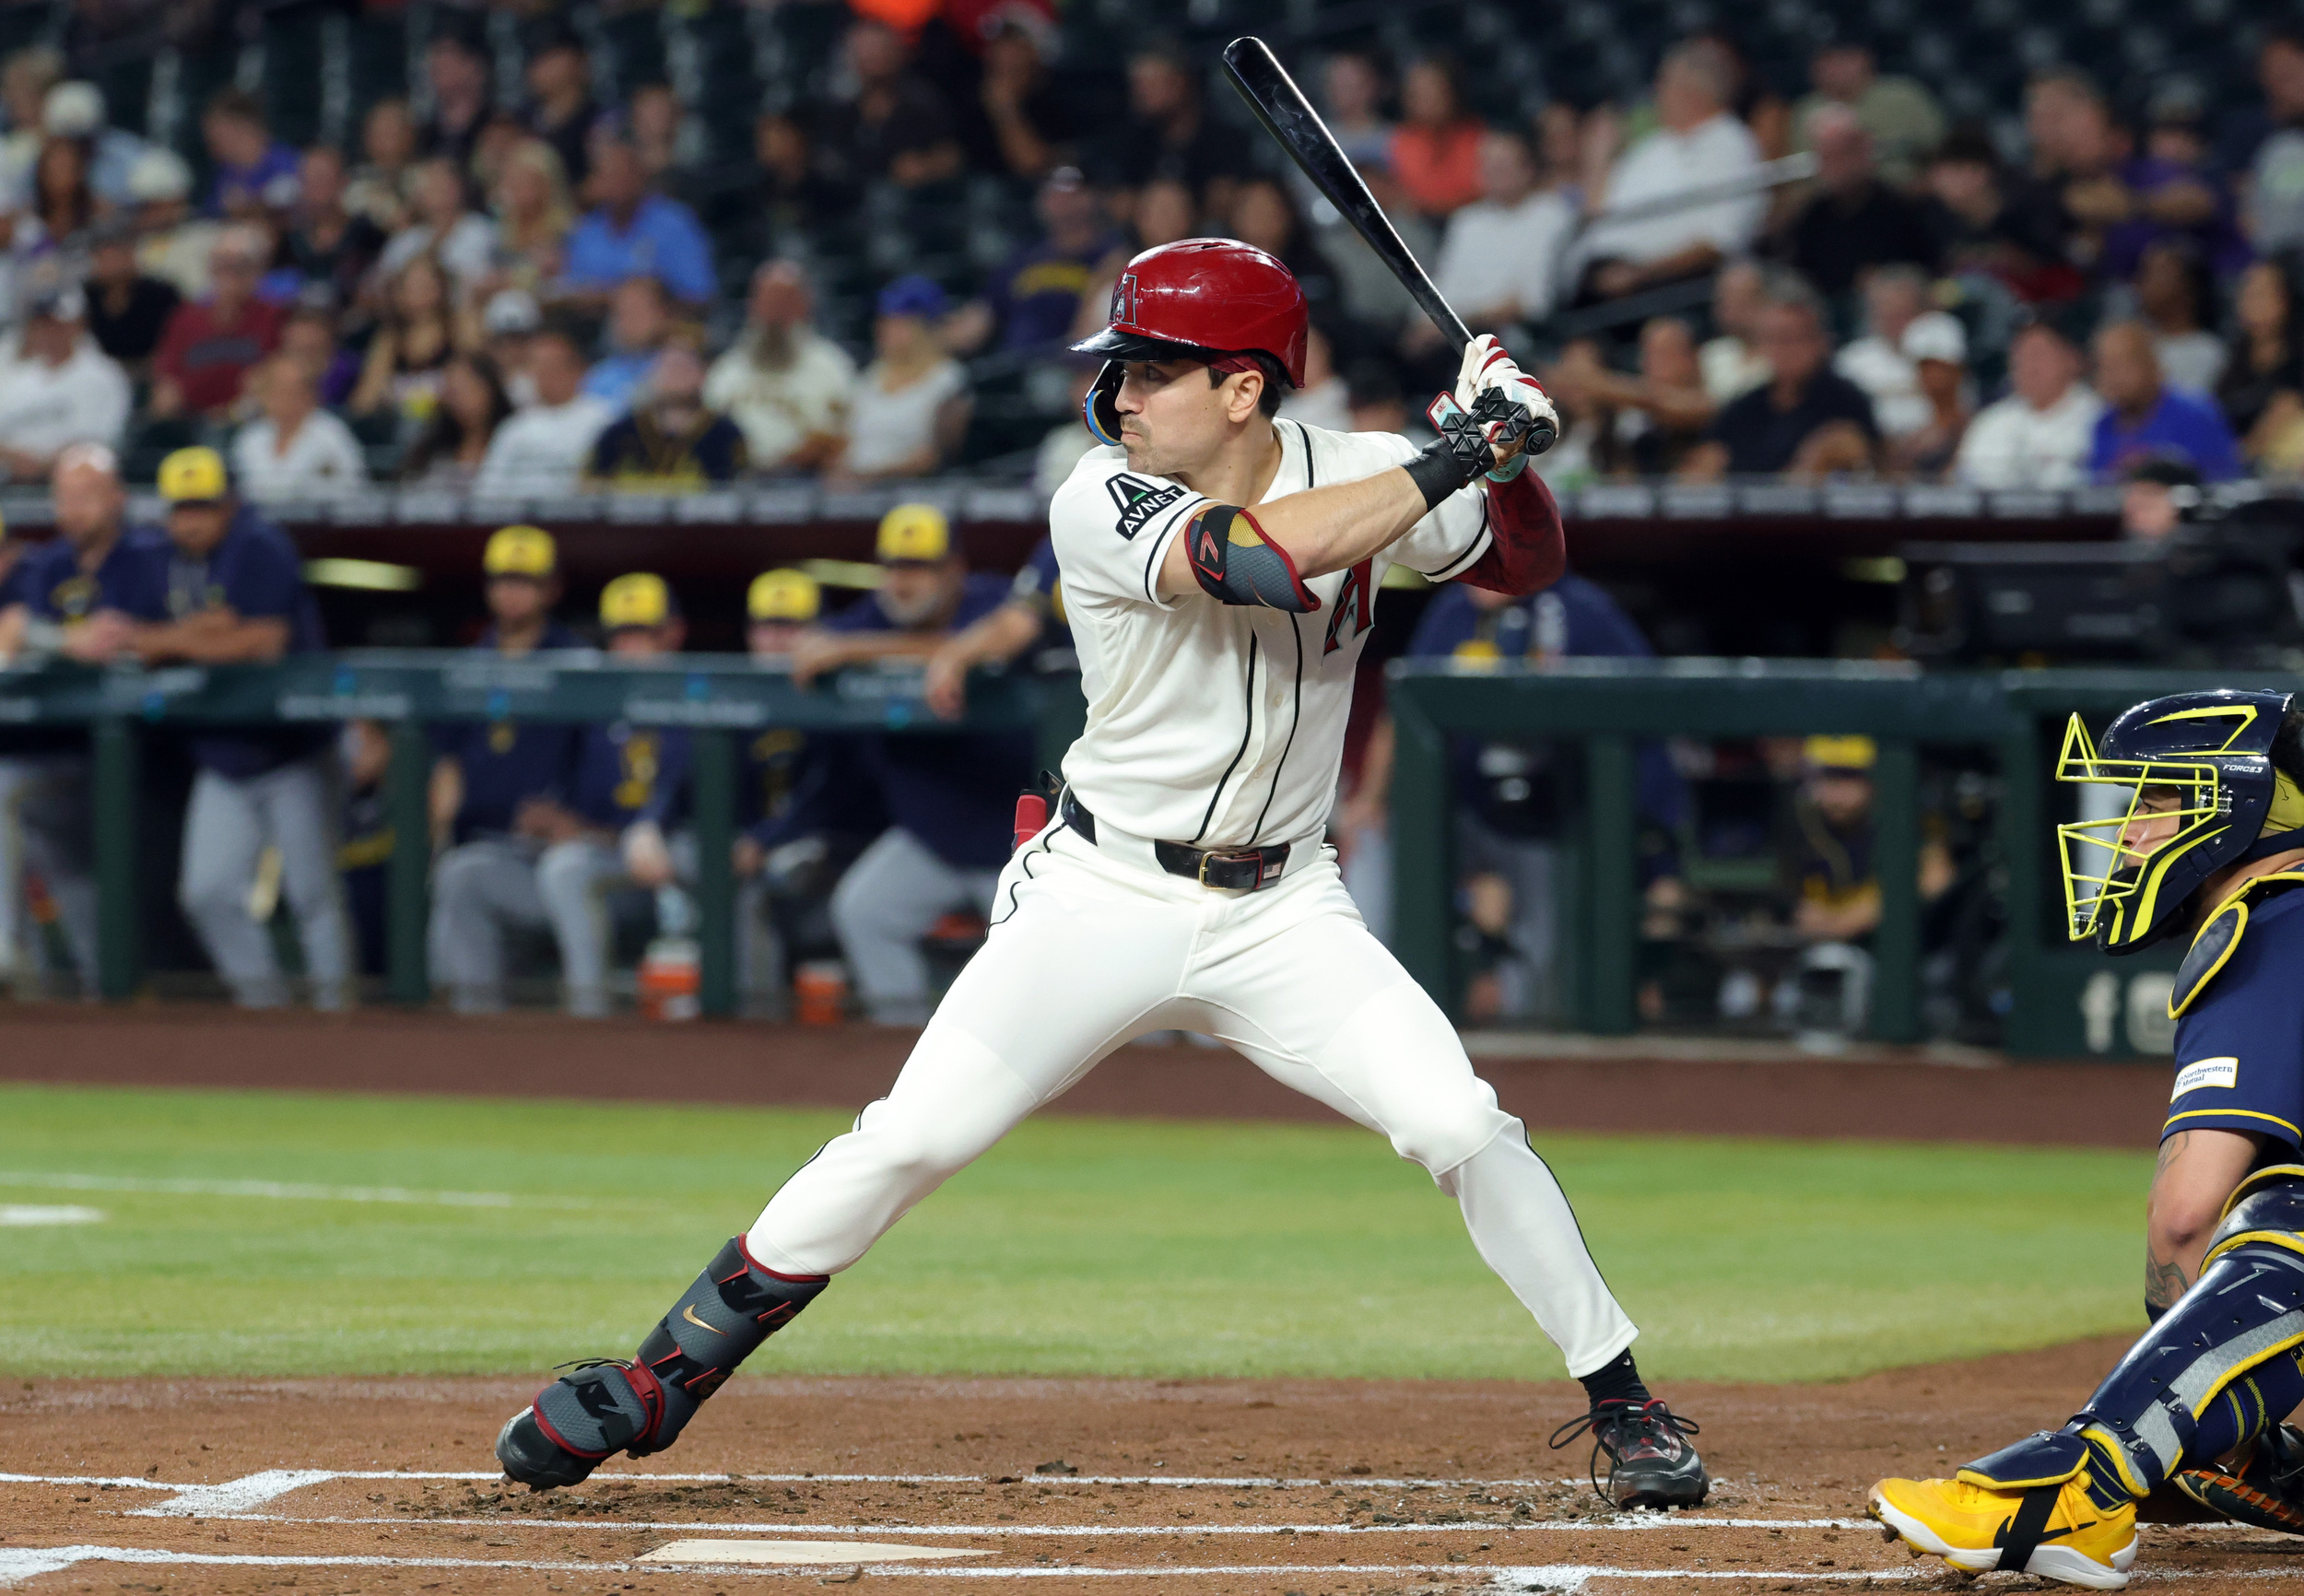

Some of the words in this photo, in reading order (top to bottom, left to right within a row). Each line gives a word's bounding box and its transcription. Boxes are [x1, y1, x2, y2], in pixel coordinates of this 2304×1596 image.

[1123, 488, 1181, 534] AVNET
[2223, 764, 2263, 774] FORCE3
[2184, 1065, 2233, 1080] Northwestern
[2182, 1074, 2205, 1087] Mutual
